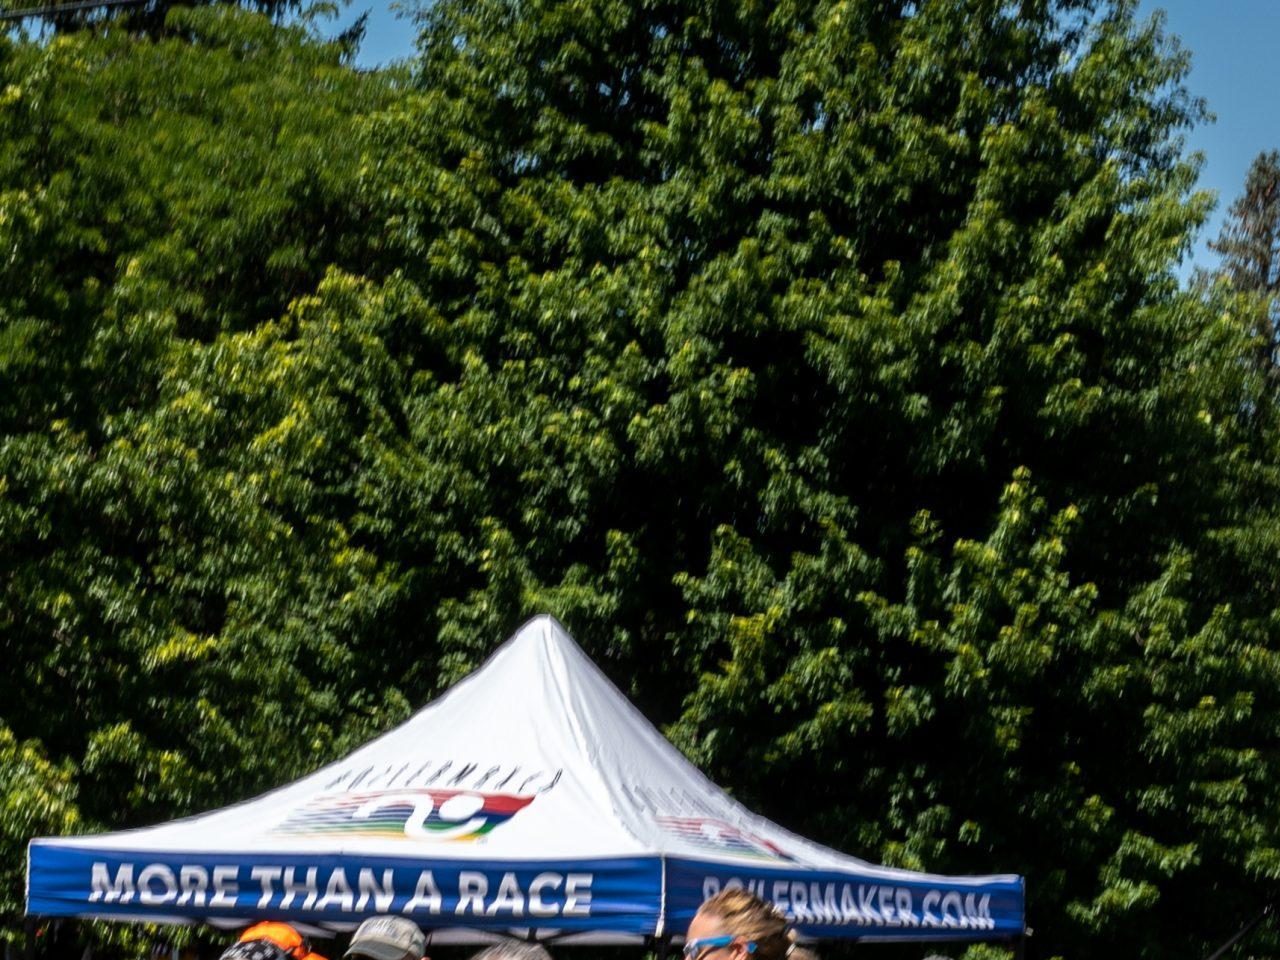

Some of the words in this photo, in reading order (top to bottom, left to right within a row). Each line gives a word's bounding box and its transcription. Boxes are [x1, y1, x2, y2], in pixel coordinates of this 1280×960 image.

[88, 862, 239, 909] MORE
[251, 866, 396, 913] THAN
[403, 870, 442, 915] A
[455, 872, 594, 918] RACE
